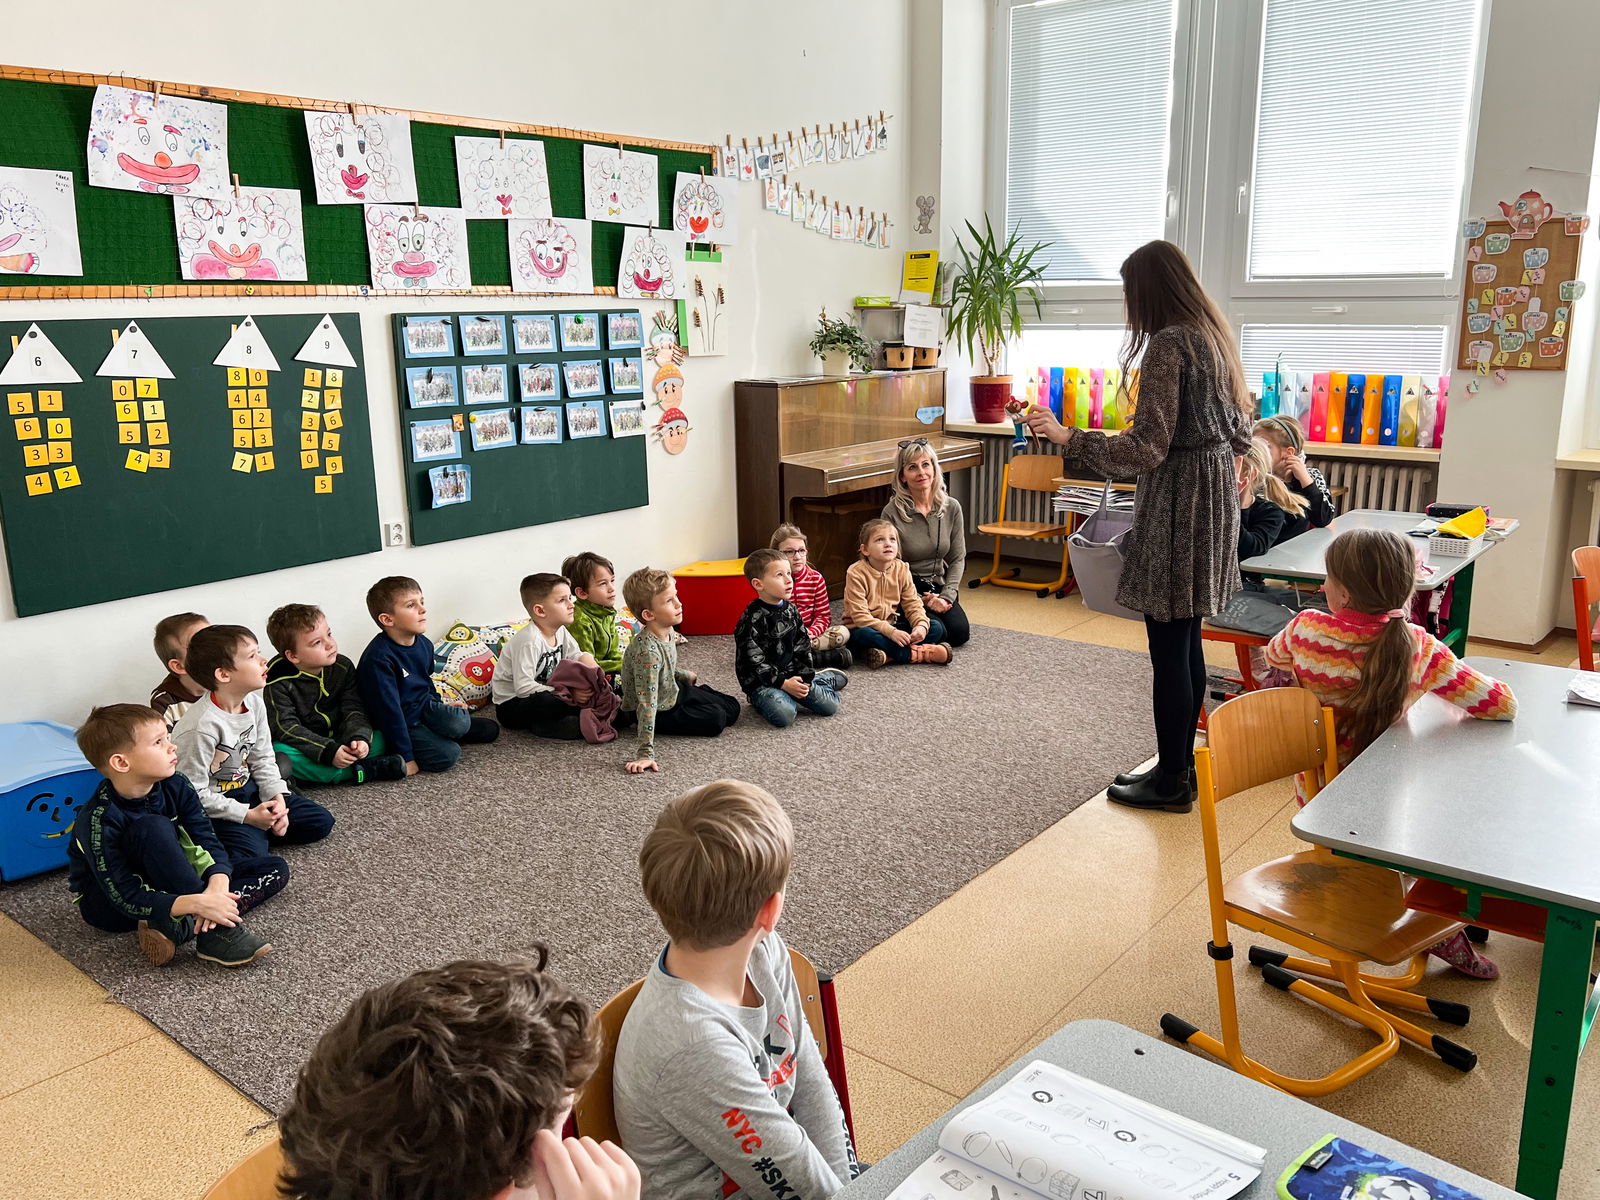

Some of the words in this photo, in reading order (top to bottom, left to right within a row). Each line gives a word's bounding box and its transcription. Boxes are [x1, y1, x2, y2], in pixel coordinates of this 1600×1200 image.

[245, 345, 252, 355] 8
[324, 340, 331, 350] 9
[131, 349, 138, 359] 7
[34, 356, 42, 367] 6
[233, 370, 241, 381] 8
[254, 371, 262, 382] 0
[309, 372, 317, 383] 1
[330, 371, 338, 383] 8
[119, 385, 127, 396] 0
[143, 384, 151, 395] 7
[17, 401, 25, 413] 5
[47, 394, 55, 406] 1
[233, 393, 241, 404] 4
[254, 393, 261, 403] 4
[307, 393, 314, 404] 2
[329, 394, 336, 404] 7
[123, 403, 131, 415] 6
[150, 404, 158, 415] 1
[238, 414, 246, 425] 6
[258, 412, 266, 423] 2
[307, 417, 314, 428] 3
[329, 415, 337, 426] 6
[23, 420, 32, 432] 6
[55, 423, 64, 435] 0
[126, 430, 134, 442] 5
[154, 428, 162, 440] 2
[239, 436, 247, 447] 5
[260, 433, 267, 444] 3
[306, 433, 313, 443] 4
[327, 439, 334, 449] 5
[32, 449, 41, 461] 3
[56, 447, 64, 459] 3
[134, 453, 142, 464] 4
[156, 451, 163, 463] 3
[239, 458, 247, 469] 7
[260, 455, 268, 466] 1
[306, 454, 314, 464] 0
[330, 461, 338, 472] 9
[34, 476, 44, 487] 4
[62, 470, 72, 482] 2
[320, 479, 327, 490] 5
[720, 1107, 763, 1155] NYC
[751, 1157, 802, 1200] #SK
